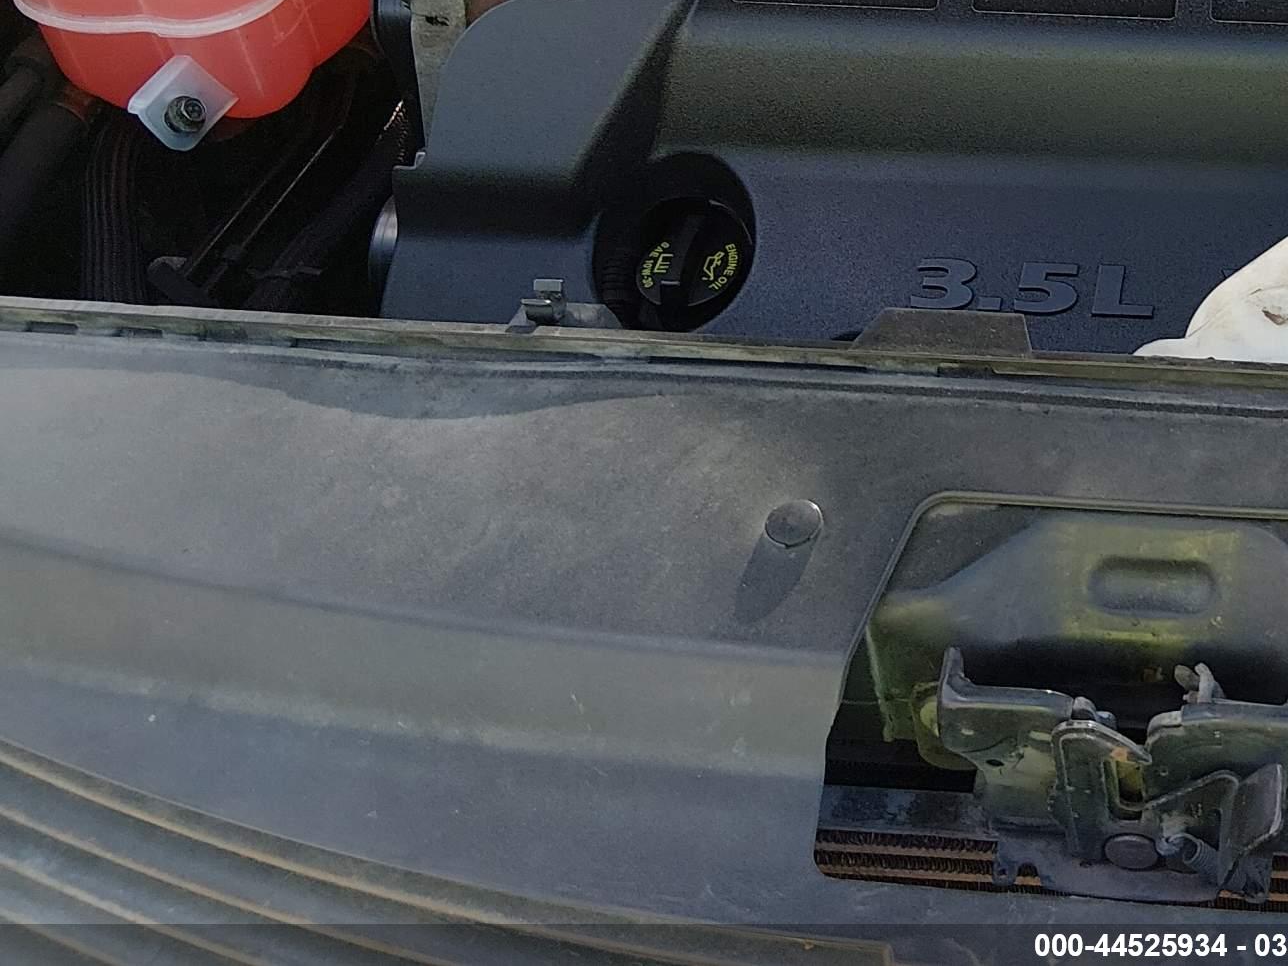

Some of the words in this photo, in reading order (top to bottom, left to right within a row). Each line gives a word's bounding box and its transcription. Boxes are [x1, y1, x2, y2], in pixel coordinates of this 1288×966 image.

[724, 243, 738, 276] ENGINE
[708, 276, 728, 290] OIL
[910, 257, 1154, 319] 3.5L
